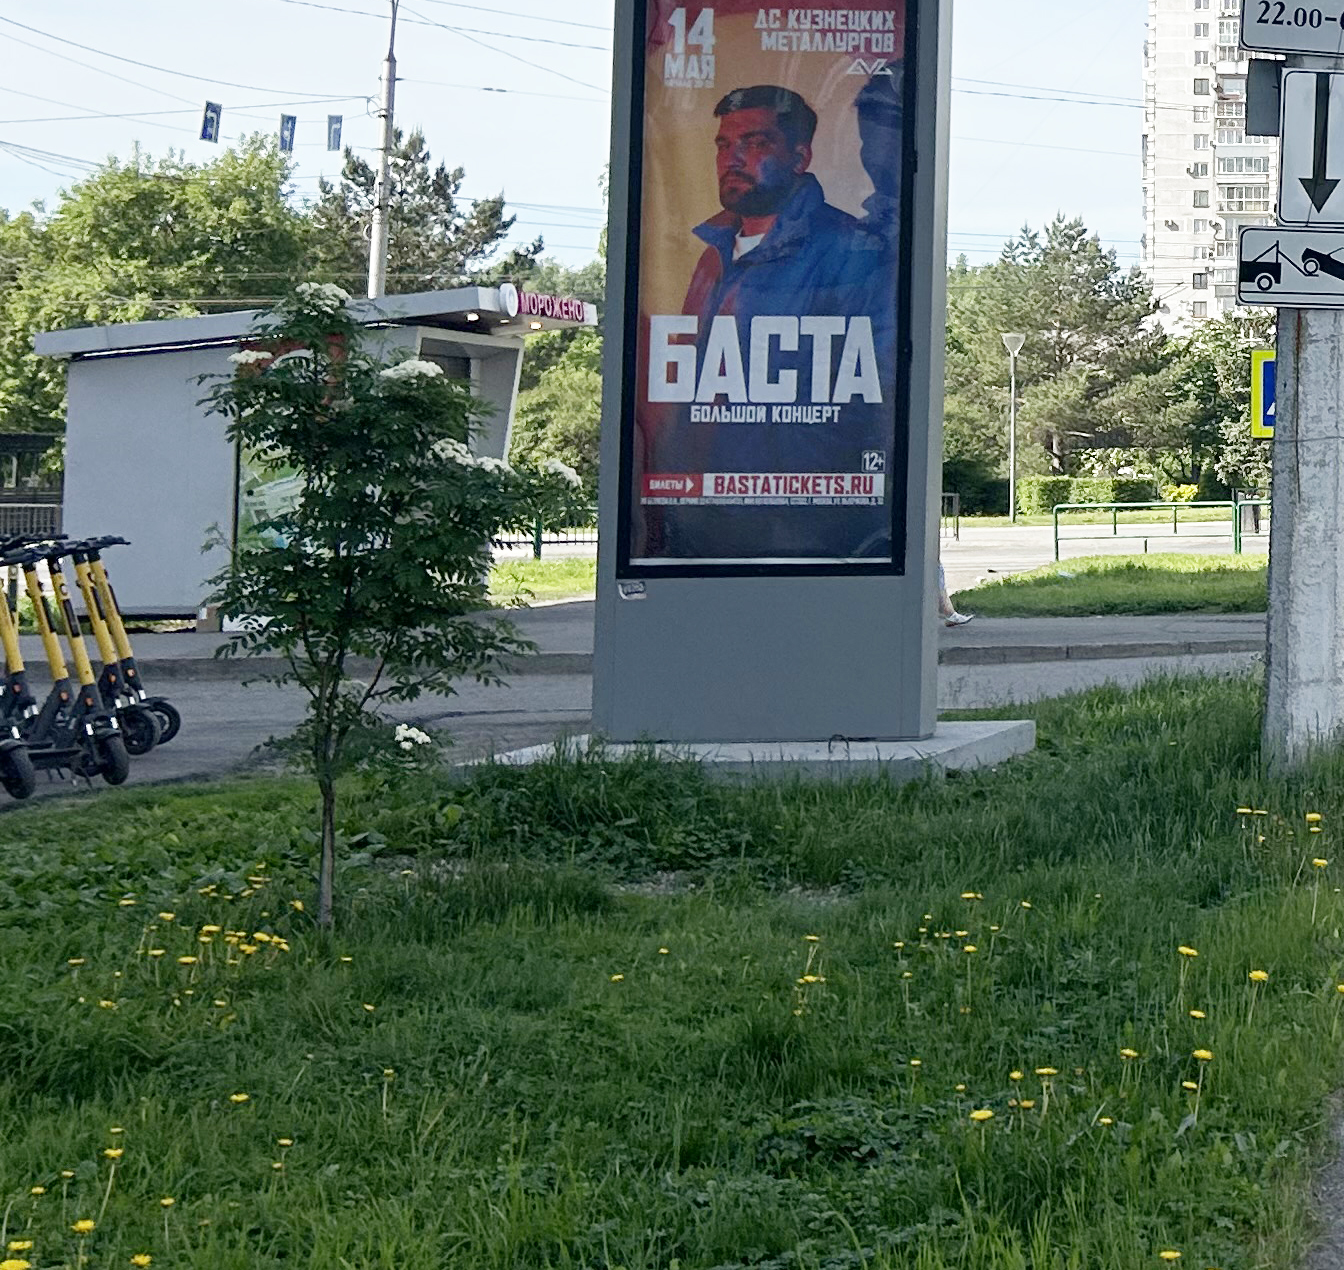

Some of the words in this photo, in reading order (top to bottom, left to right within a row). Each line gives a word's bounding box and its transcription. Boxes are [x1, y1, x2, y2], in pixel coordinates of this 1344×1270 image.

[667, 7, 716, 54] 14
[754, 8, 781, 29] ДС
[787, 9, 896, 31] КУЗНЕЦКИХ
[761, 31, 895, 53] МЕТАЛЛУРГОВ
[664, 53, 716, 80] МАЯ
[648, 315, 883, 403] БАСТА
[690, 404, 766, 423] БОЛЬШОЙ
[772, 406, 841, 424] КОНЦЕРТ
[863, 452, 884, 471] 12+
[649, 479, 684, 490] БИЛЕТЫ
[714, 475, 874, 495] BASTATICKETS.RU
